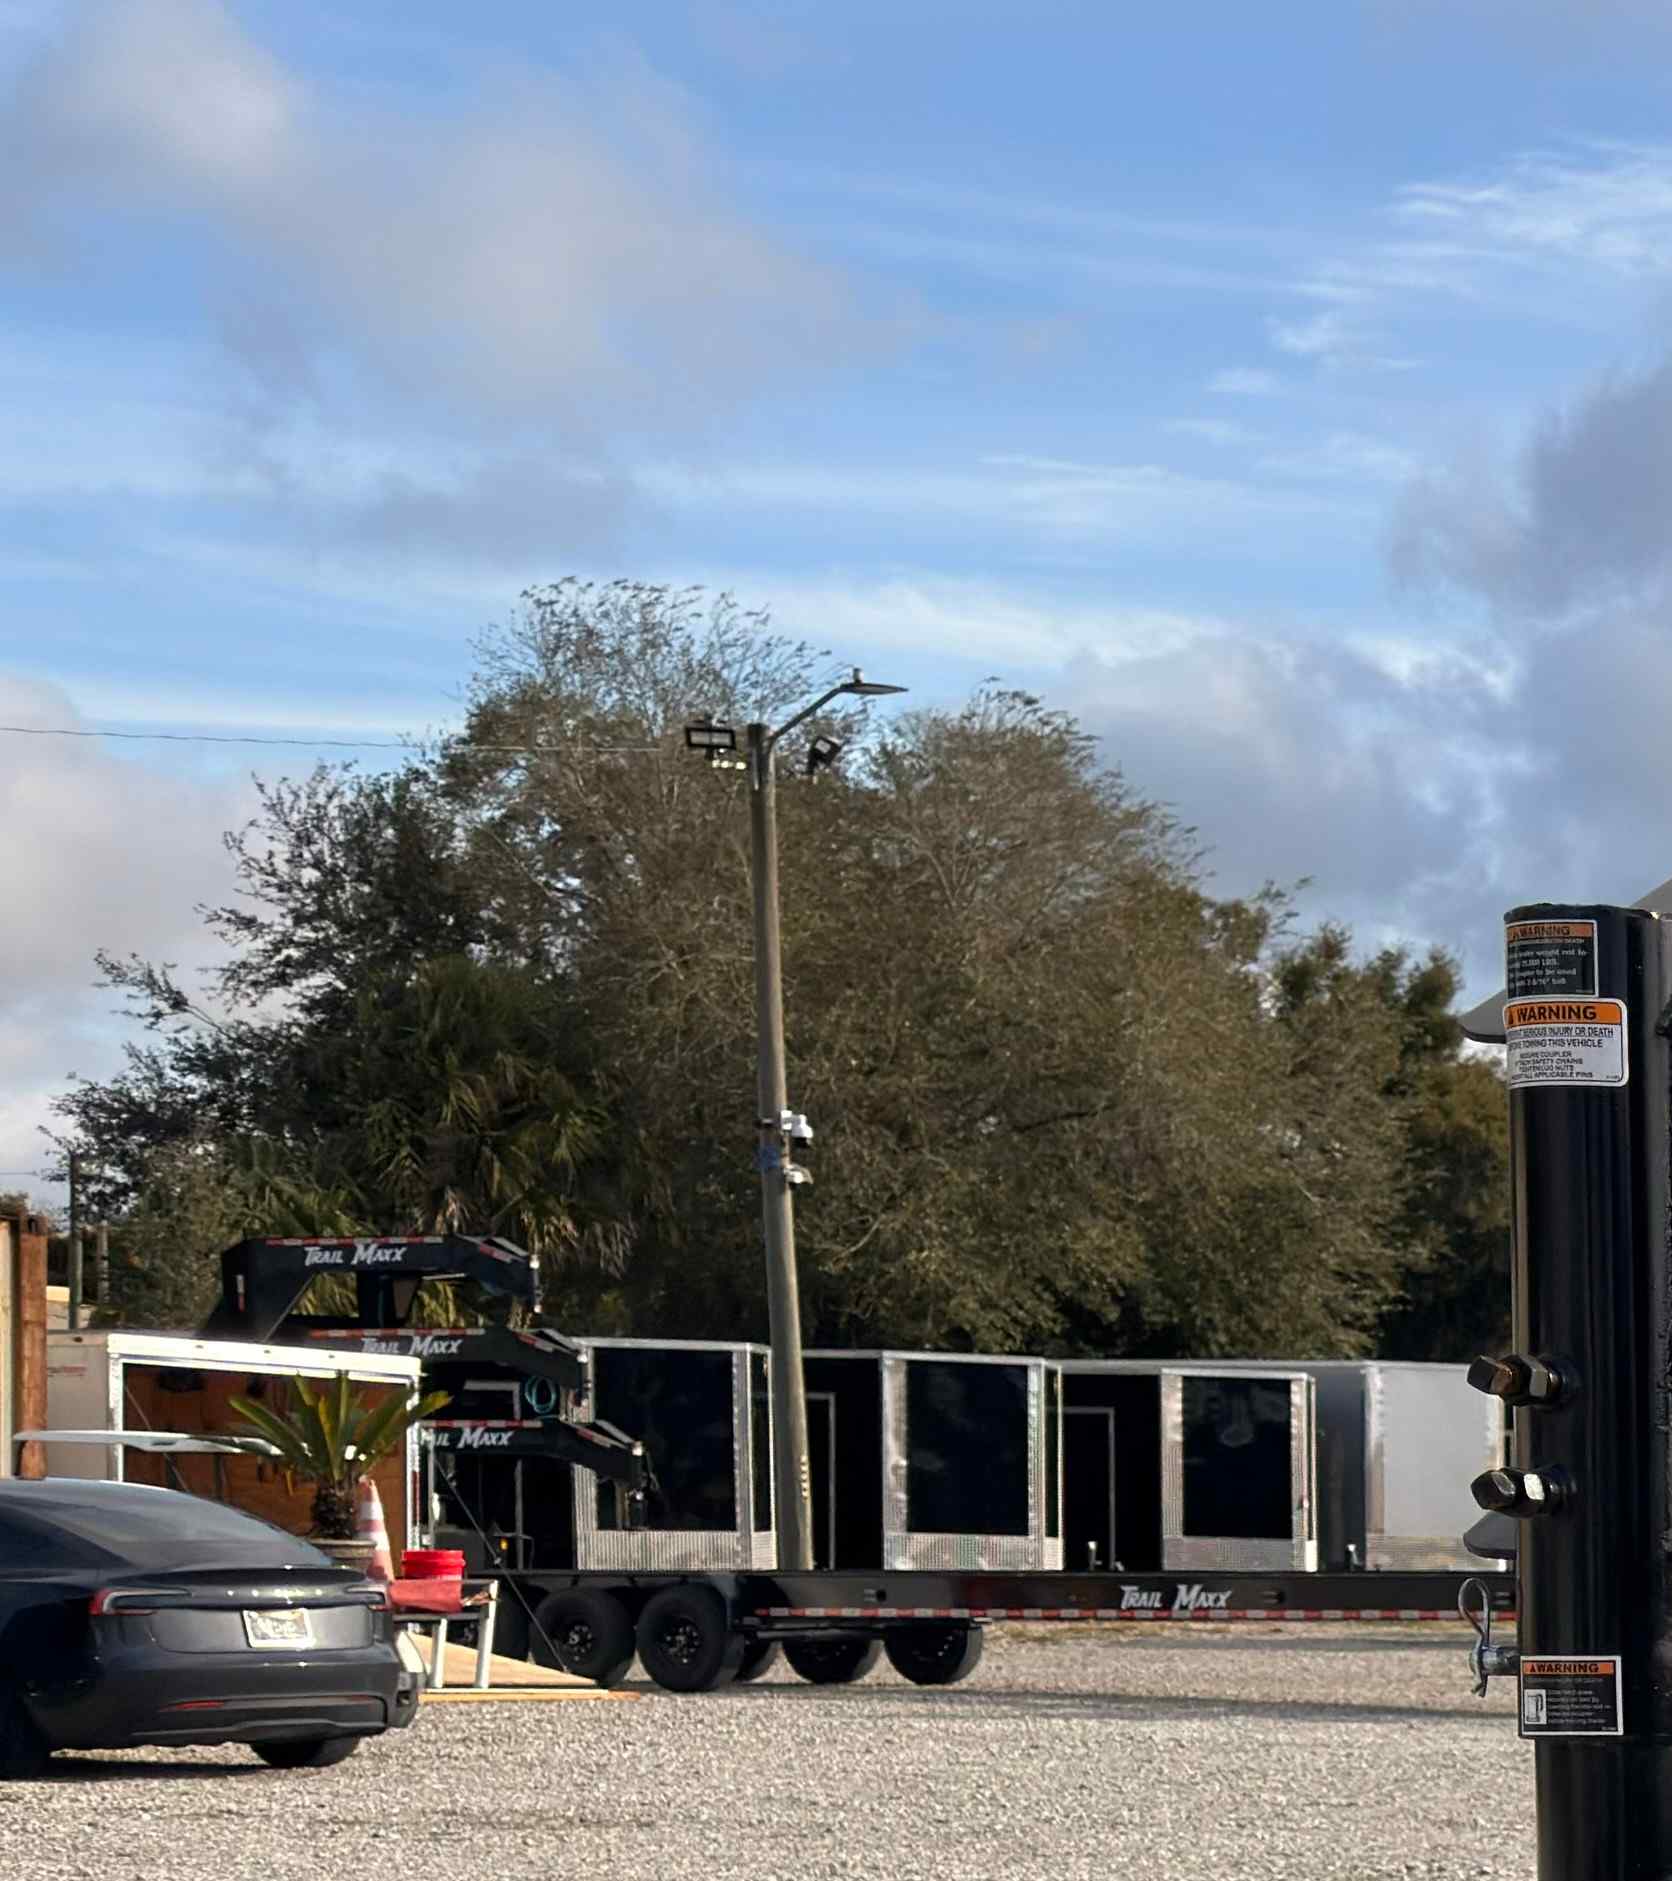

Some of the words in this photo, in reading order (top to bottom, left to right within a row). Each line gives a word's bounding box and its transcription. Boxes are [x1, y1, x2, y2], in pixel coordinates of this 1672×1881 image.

[1517, 1005, 1597, 1022] WARNING
[1588, 1027, 1614, 1038] DEATH
[1566, 1039, 1603, 1048] VEHICLE
[1536, 1663, 1599, 1673] WARNING
